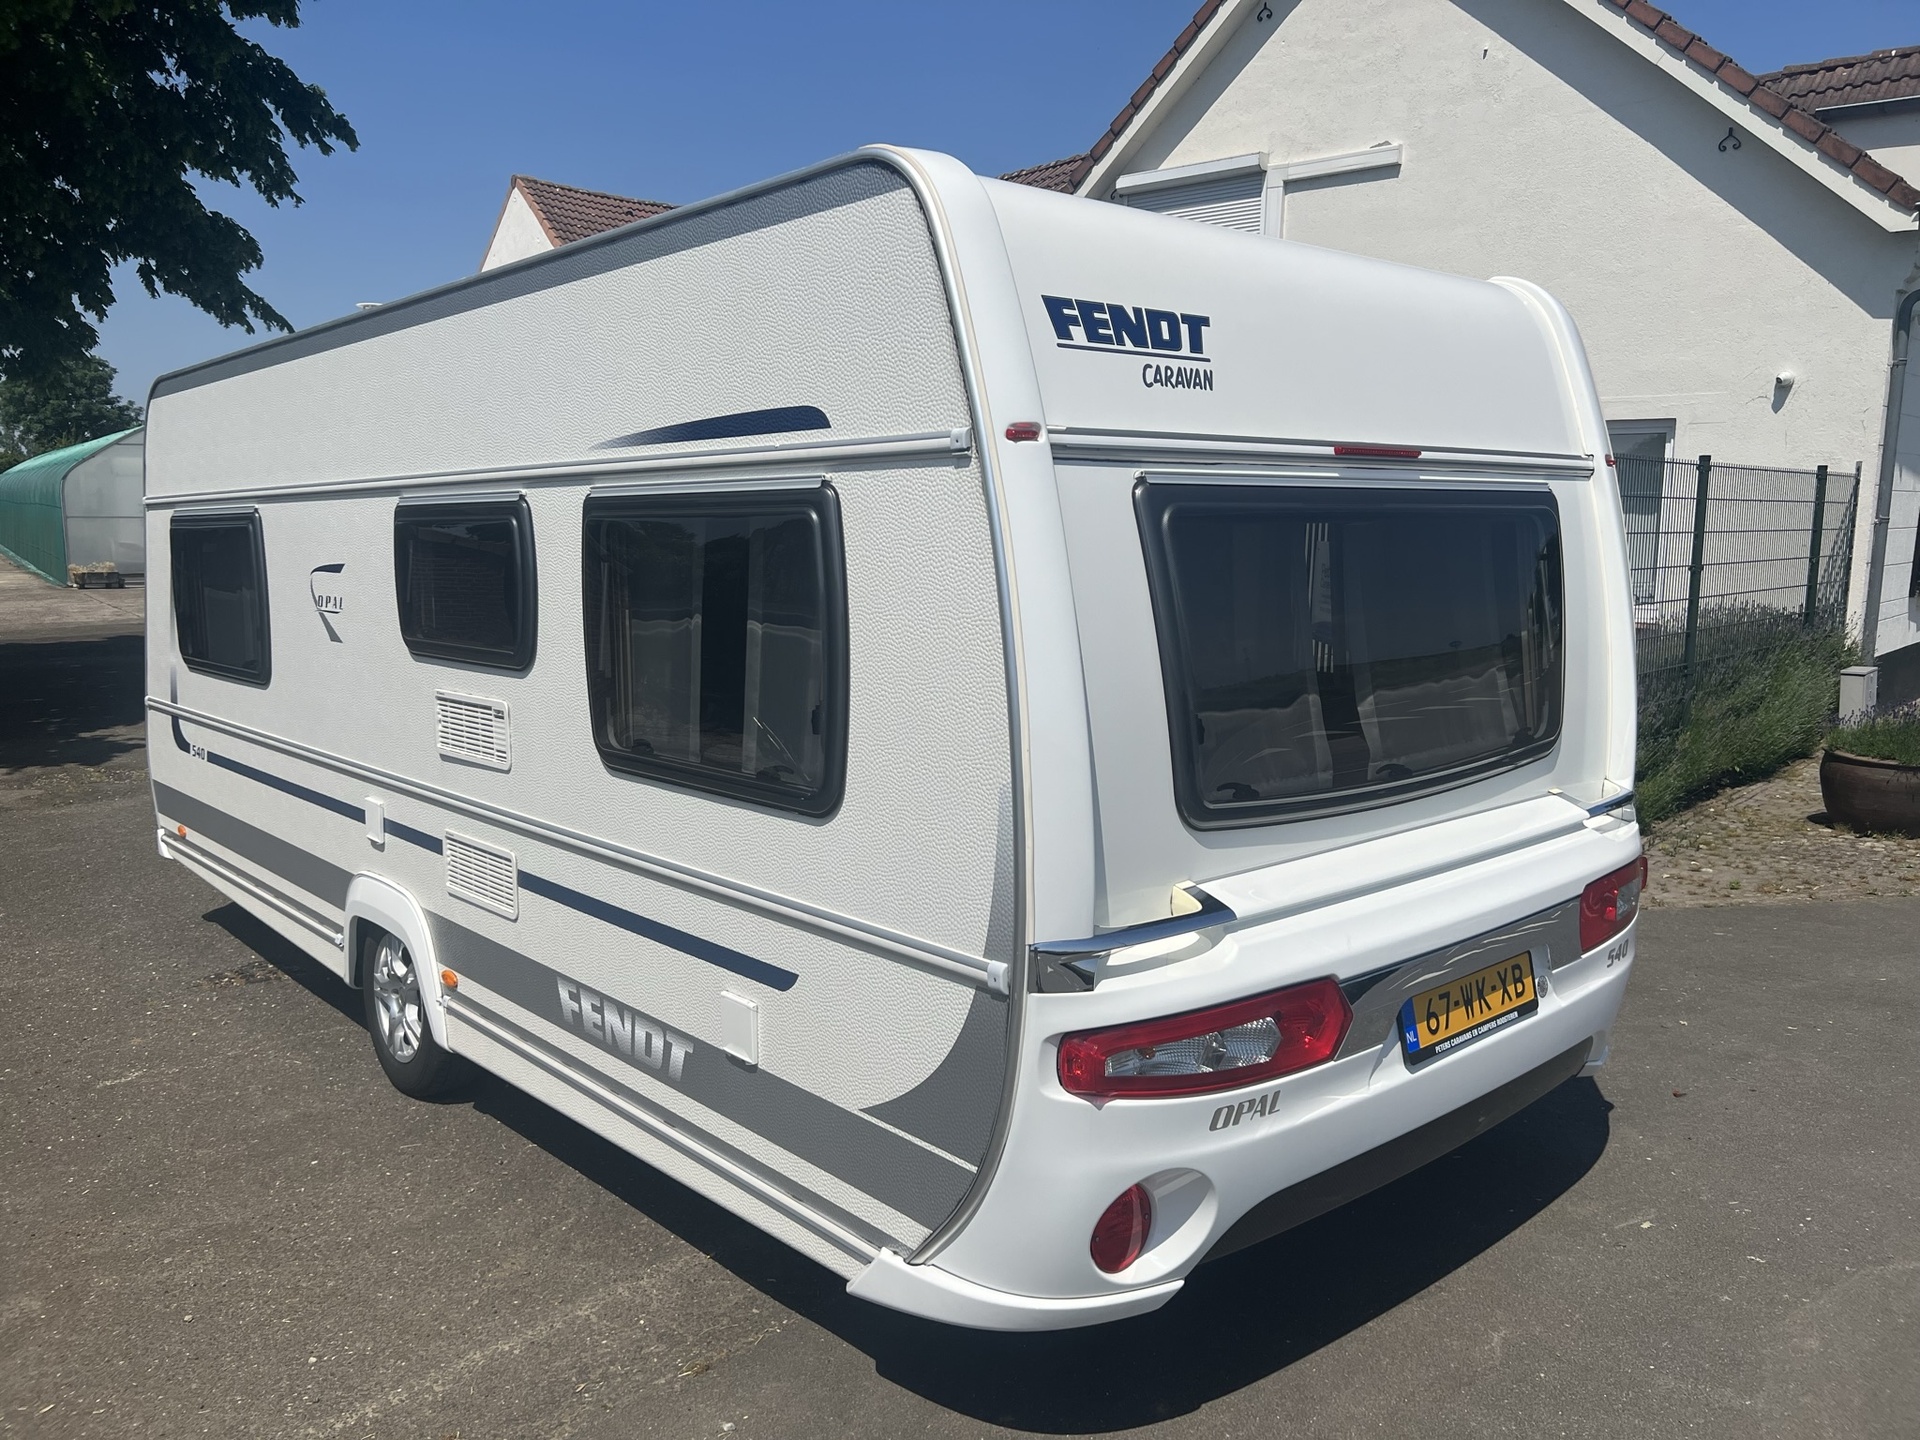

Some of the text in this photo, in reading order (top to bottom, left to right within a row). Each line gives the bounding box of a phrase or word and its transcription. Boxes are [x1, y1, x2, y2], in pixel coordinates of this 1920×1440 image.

[1041, 295, 1211, 355] FENDT
[1142, 363, 1214, 391] CARAVAN
[316, 594, 344, 611] OPAL
[192, 744, 206, 760] 540
[1606, 938, 1629, 968] 540
[1425, 963, 1526, 1036] 67-WK-XB
[556, 975, 695, 1082] FENDT
[1406, 1030, 1418, 1044] NL
[1434, 1041, 1451, 1054] PETERS
[1450, 1031, 1473, 1047] CARAVANS
[1478, 1020, 1498, 1034] CAMPERS
[1209, 1089, 1281, 1132] OPAL
